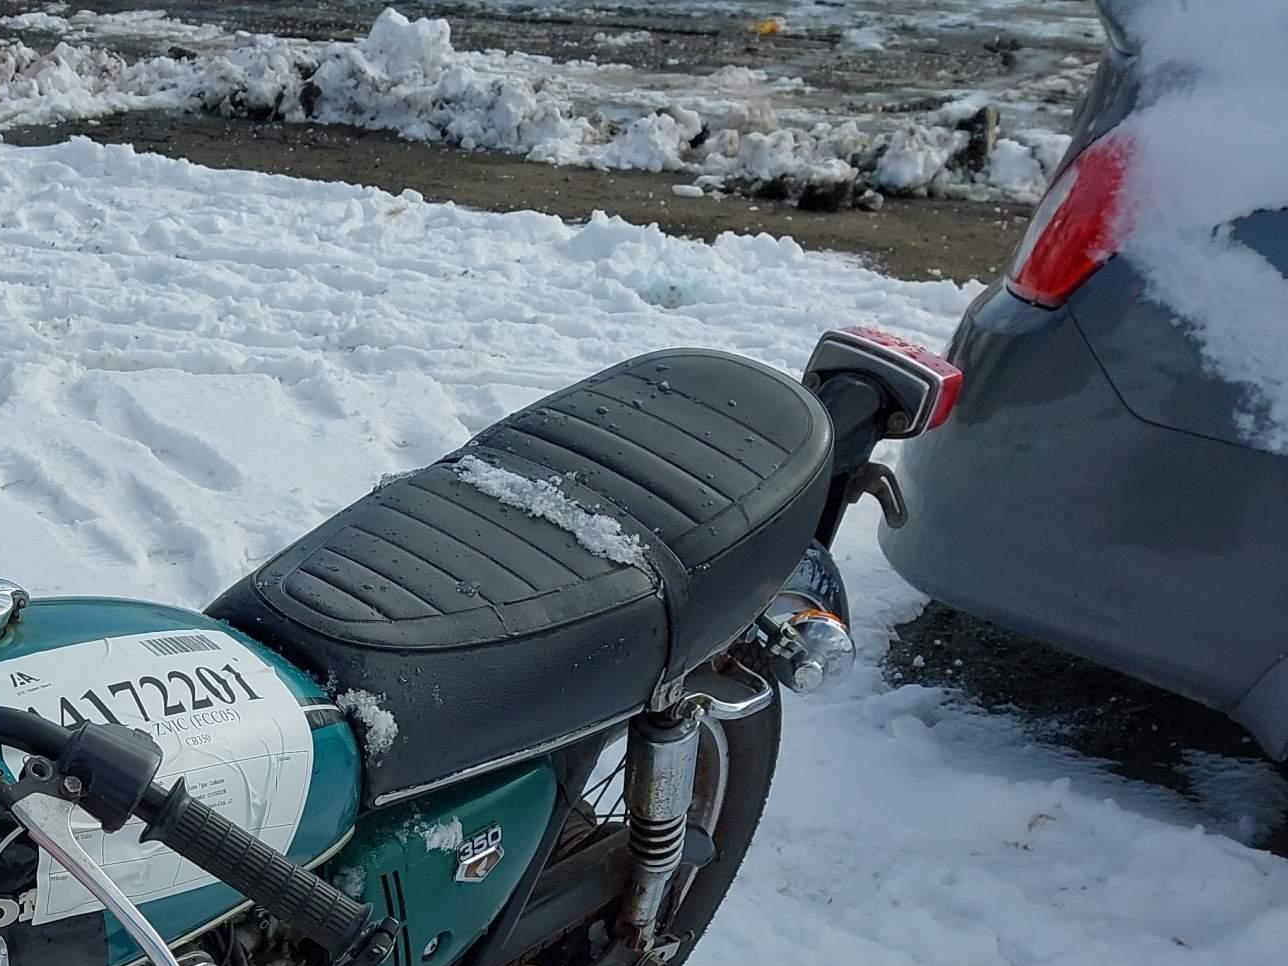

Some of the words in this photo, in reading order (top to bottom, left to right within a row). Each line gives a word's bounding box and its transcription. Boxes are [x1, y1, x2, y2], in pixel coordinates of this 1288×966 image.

[28, 663, 265, 731] 4172201
[152, 717, 190, 736] ZVIC
[190, 708, 242, 731] (FCC05)
[185, 733, 212, 746] CB350
[459, 825, 502, 861] 350
